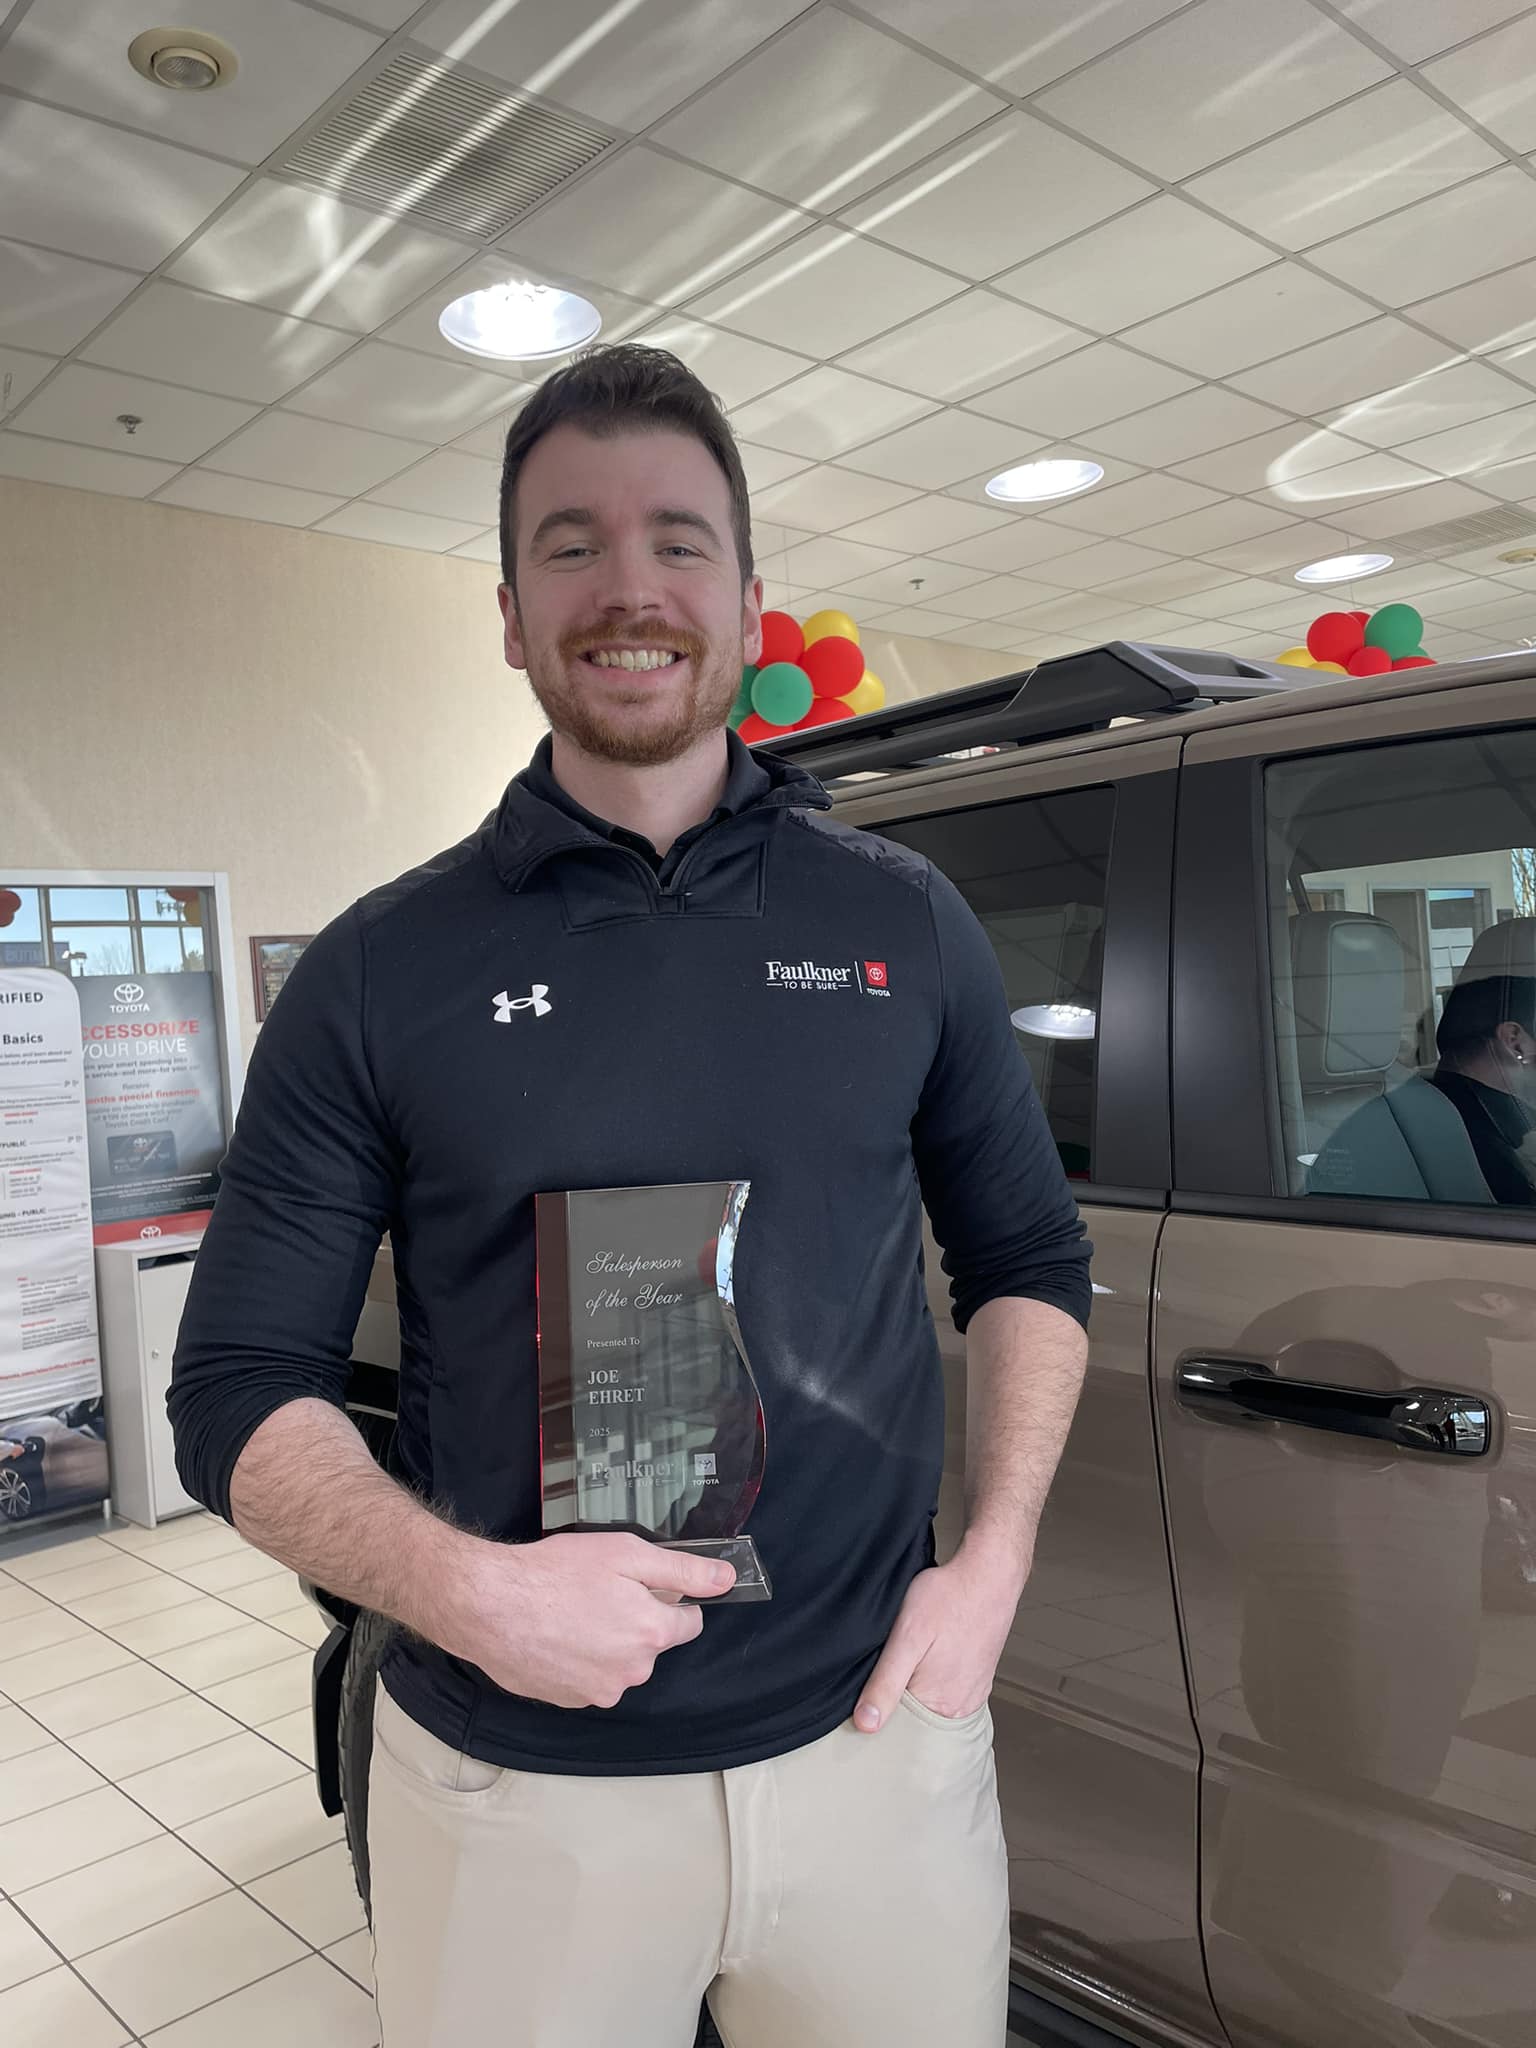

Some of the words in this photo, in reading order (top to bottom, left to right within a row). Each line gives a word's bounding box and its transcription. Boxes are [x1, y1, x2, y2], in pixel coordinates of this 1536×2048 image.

[765, 961, 850, 982] Faulkner
[784, 981, 798, 989] TO
[801, 981, 813, 990] BE
[816, 982, 839, 990] SURE
[866, 987, 891, 997] TOYOTA
[110, 1003, 150, 1013] TOYOTA
[3, 1032, 43, 1045] Basics
[136, 1038, 187, 1056] DRIVE
[586, 1251, 683, 1278] Salesperson
[586, 1288, 607, 1316] of
[605, 1288, 628, 1308] the
[634, 1282, 683, 1309] Year
[587, 1337, 627, 1349] Presented
[629, 1336, 640, 1345] To
[587, 1370, 619, 1385] JOE
[589, 1387, 645, 1405] EHRET
[590, 1427, 610, 1438] 2025
